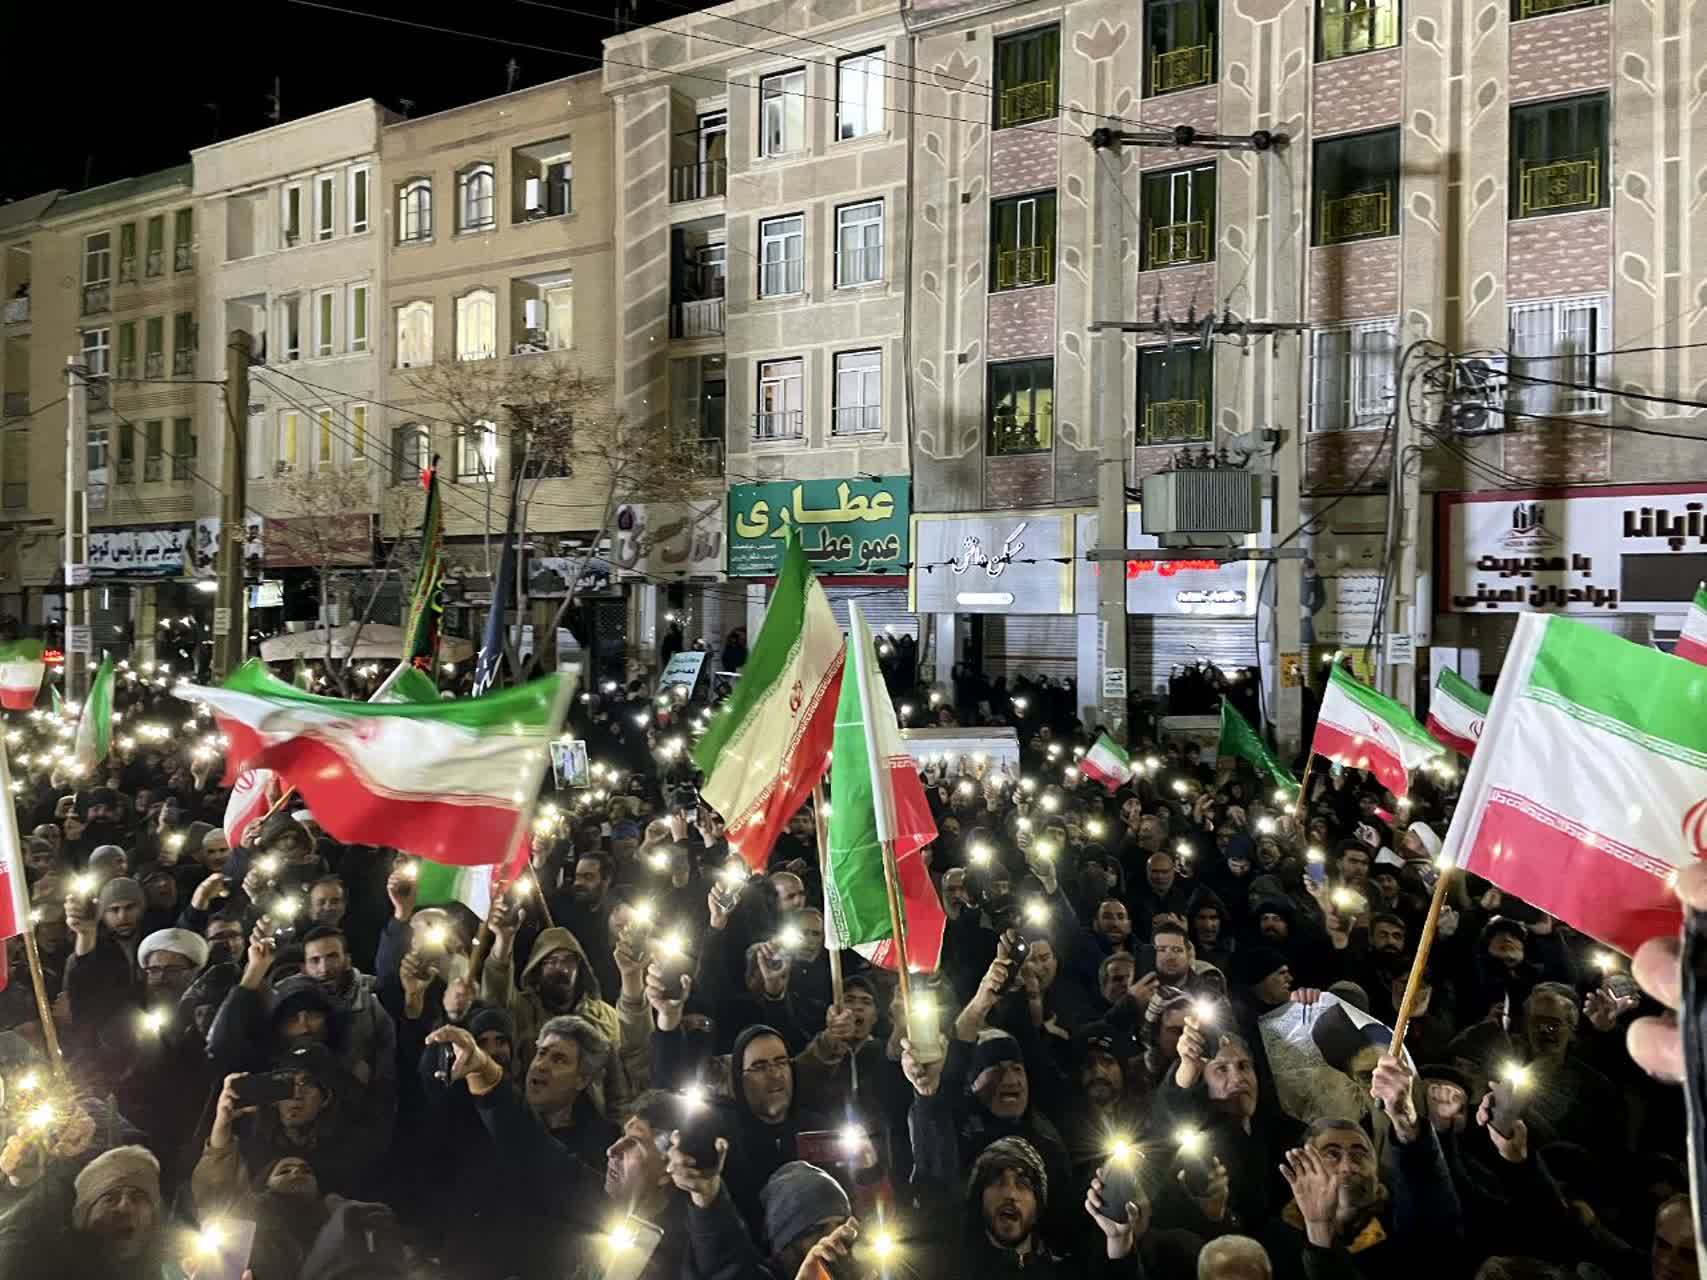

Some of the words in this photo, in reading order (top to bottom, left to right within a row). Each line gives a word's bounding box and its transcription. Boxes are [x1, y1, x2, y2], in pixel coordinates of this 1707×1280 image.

[735, 481, 895, 538] عطاری
[796, 525, 854, 562] عطا
[858, 533, 900, 573] عمو
[1477, 554, 1567, 578] مدیریت
[1571, 553, 1592, 578] با
[1453, 582, 1525, 609] امینی
[1529, 584, 1619, 610] برادران
